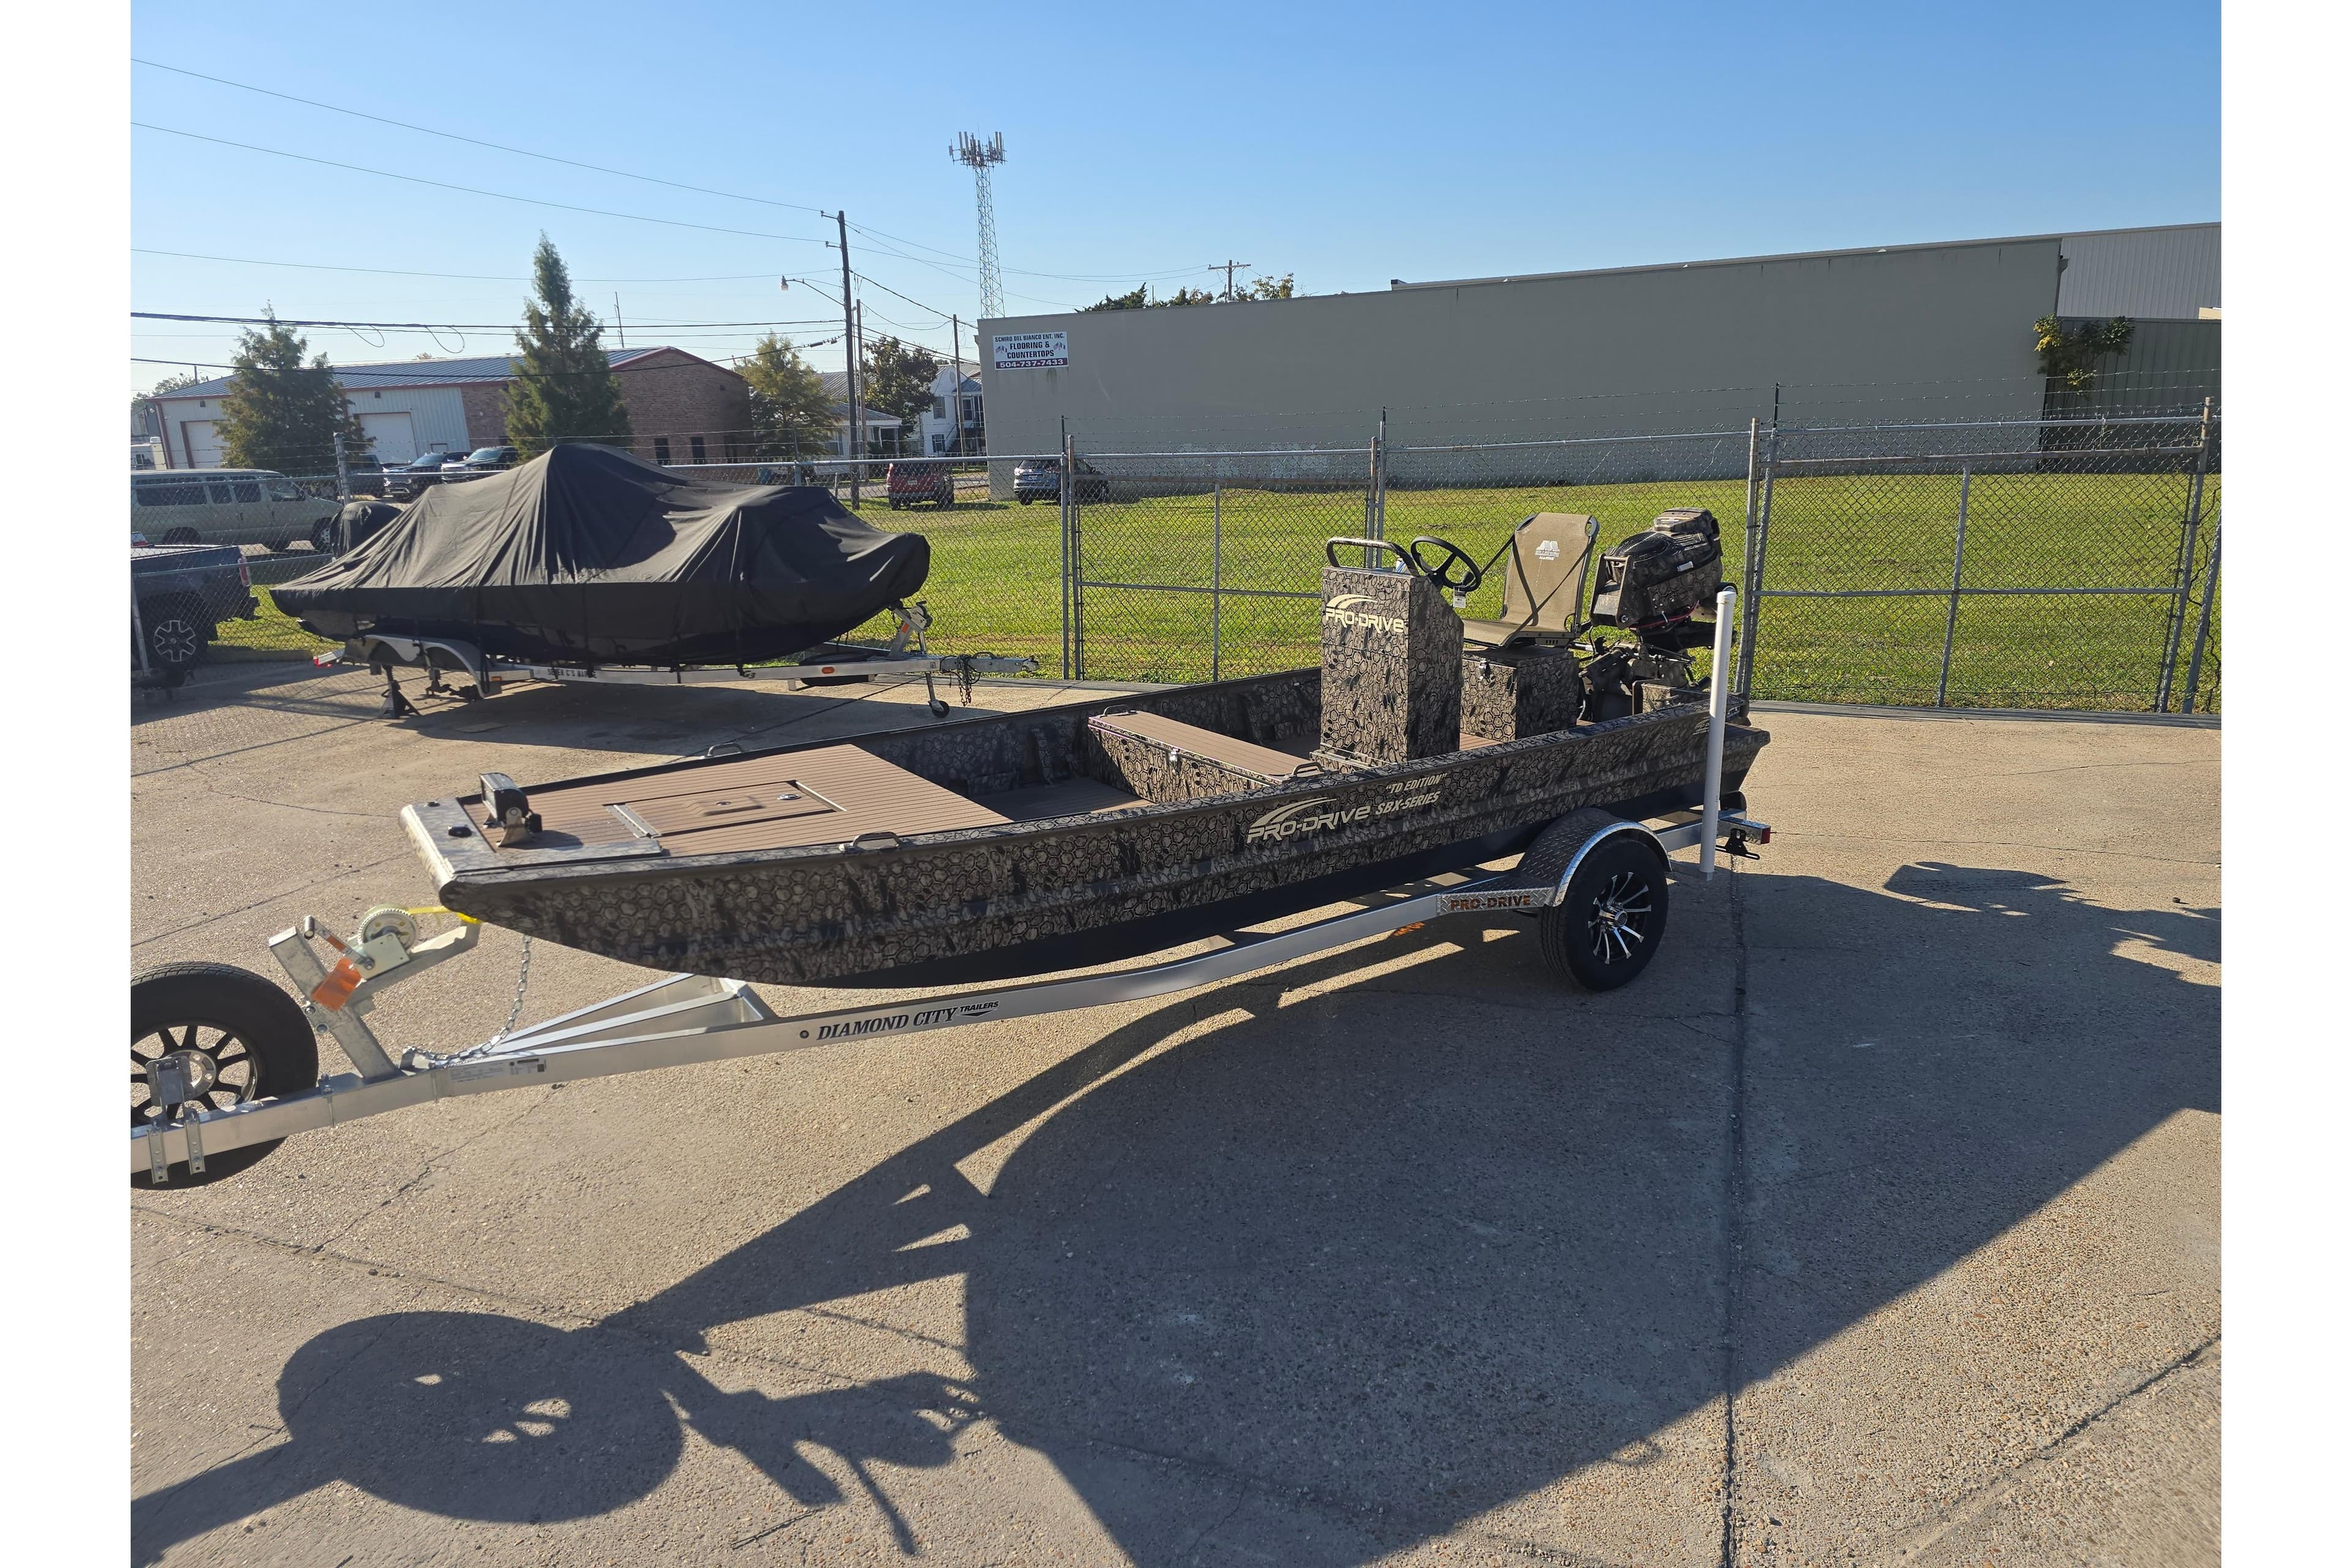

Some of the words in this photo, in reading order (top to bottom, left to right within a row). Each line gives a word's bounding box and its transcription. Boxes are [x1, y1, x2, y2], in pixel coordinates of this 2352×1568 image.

[1007, 350, 1054, 359] COUNTERTOPS
[1000, 358, 1064, 368] 504-737-7433
[1375, 791, 1441, 815] SBX-SERIES
[1450, 895, 1531, 911] PRO-DRIVE
[816, 1014, 909, 1040] DIAMOND
[913, 1007, 958, 1027] CITY
[960, 1001, 999, 1012] TRAILERS
